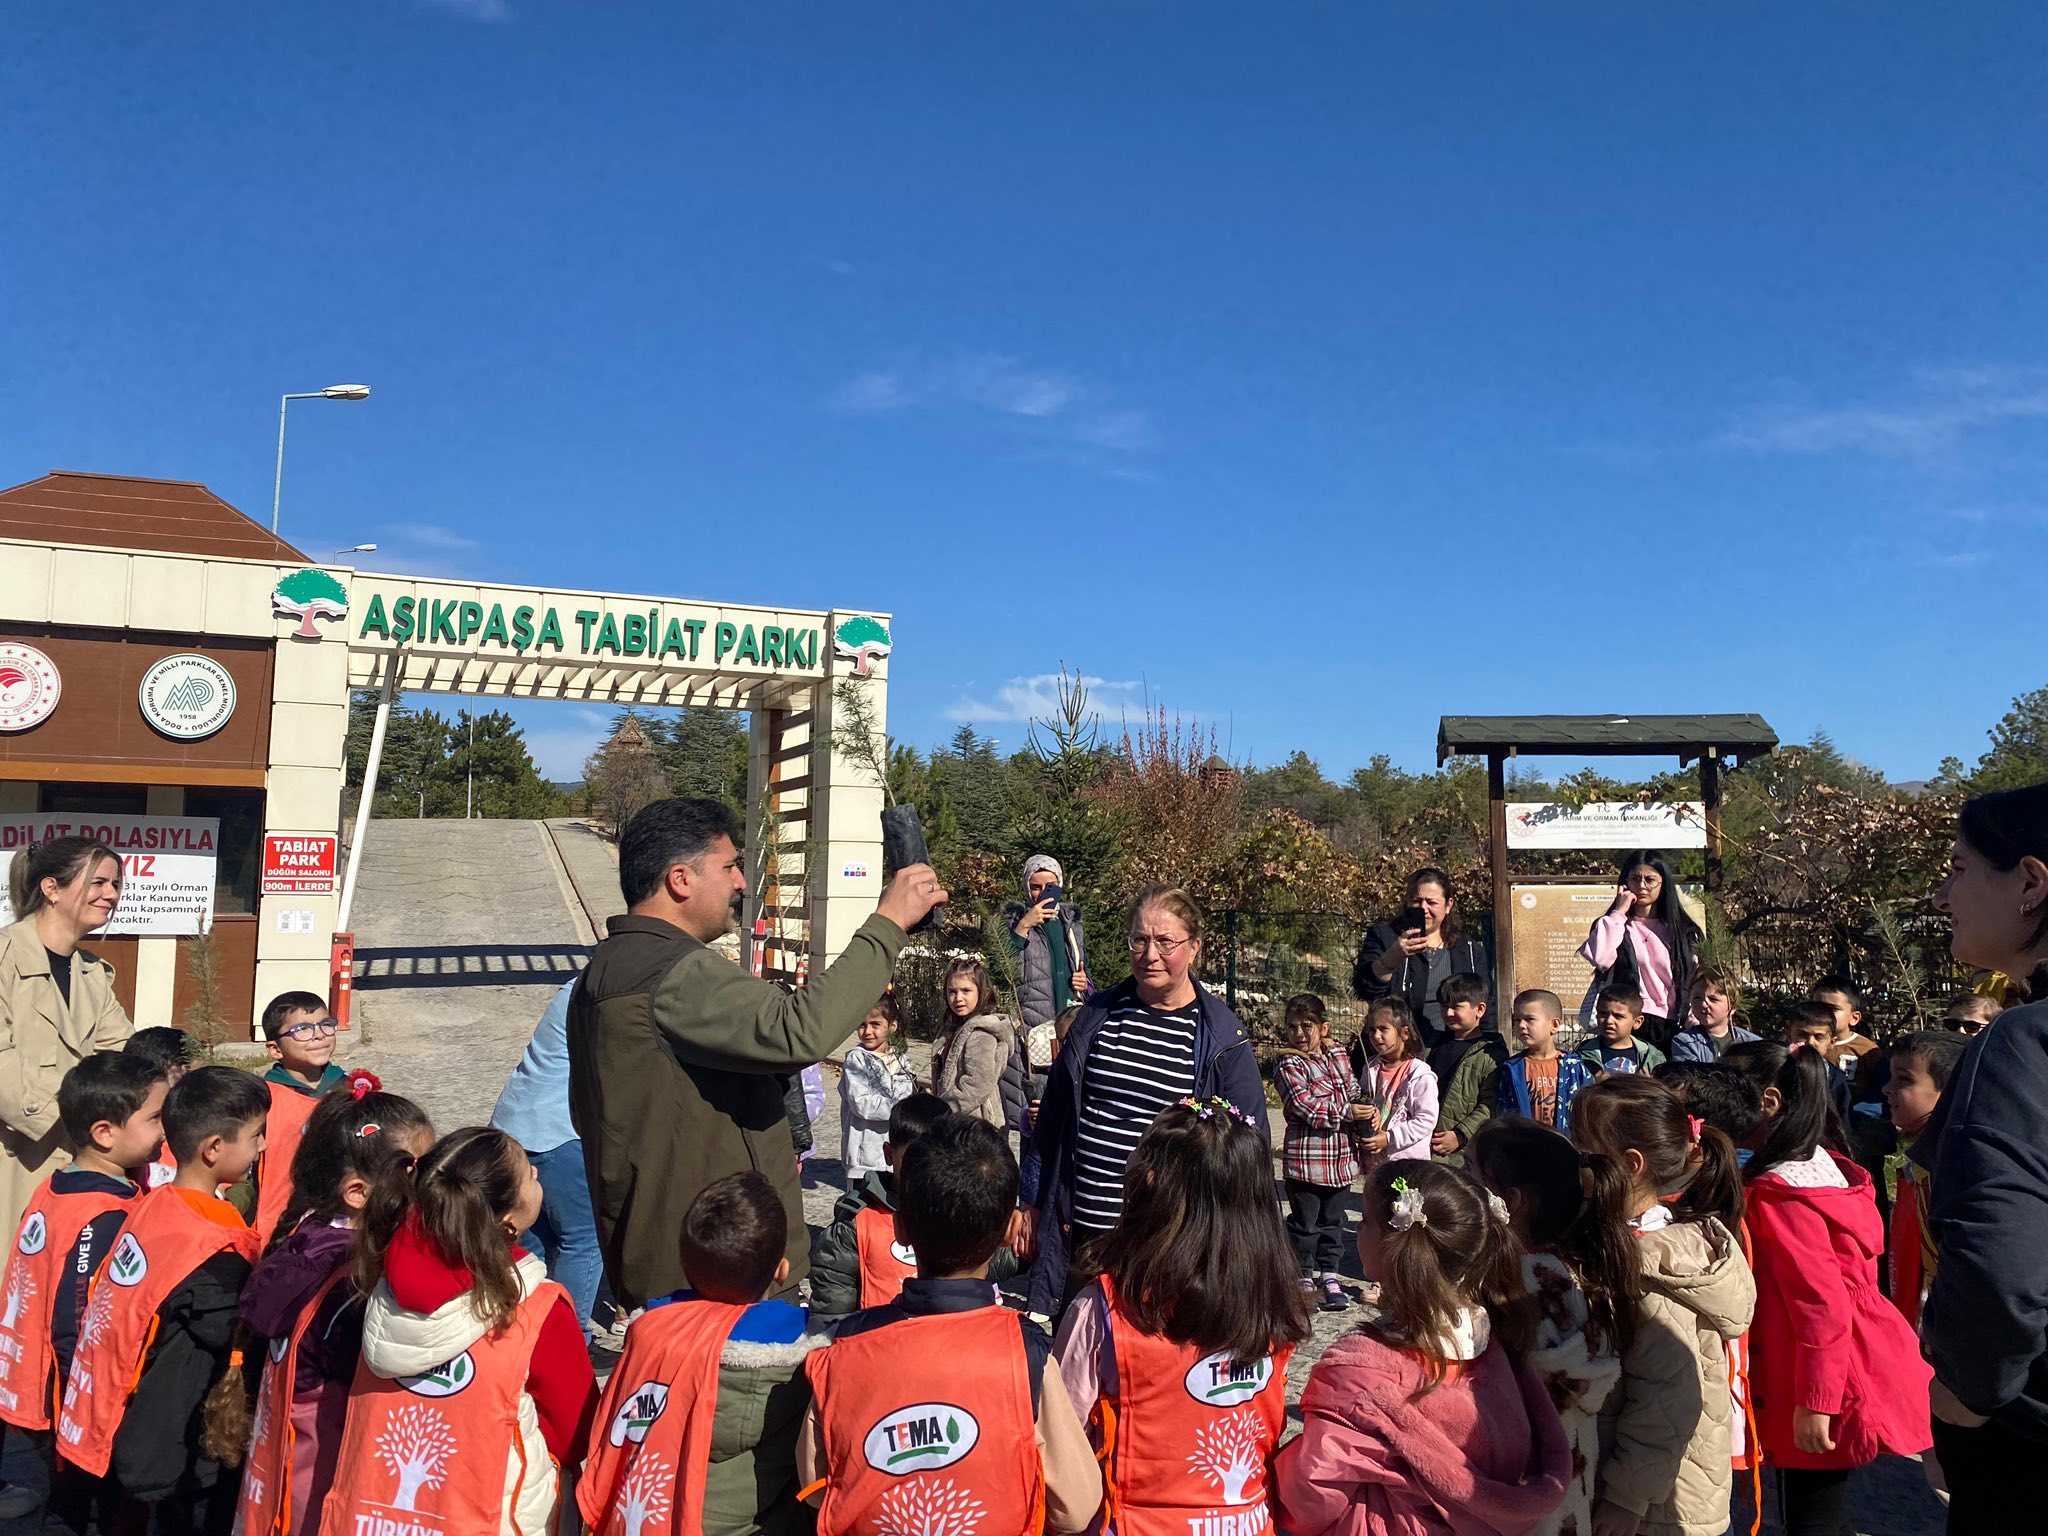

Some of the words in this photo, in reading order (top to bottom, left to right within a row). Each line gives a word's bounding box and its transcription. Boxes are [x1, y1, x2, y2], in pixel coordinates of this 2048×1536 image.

[360, 594, 564, 652] AŞIKPAŞA
[576, 608, 707, 658] TABİAT
[716, 622, 818, 666] PARKI
[181, 660, 217, 675] PARKLAR
[151, 675, 160, 685] VE
[215, 674, 229, 697] GENEL
[147, 686, 161, 717] KORUMA
[80, 825, 214, 850] DOLASIYLA
[273, 838, 328, 853] TABİAT
[279, 854, 320, 866] PARK
[267, 868, 296, 876] DÜĞÜN
[124, 882, 136, 891] 31
[140, 882, 168, 892] sayılı
[170, 883, 208, 892] Orman
[264, 882, 292, 890] 900m
[295, 881, 331, 891] İLERDE
[121, 893, 147, 902] rklar
[149, 894, 192, 902] Kanunu
[113, 915, 153, 924] acaktır.
[77, 1243, 91, 1274] GIVE
[883, 1416, 943, 1452] TEMA
